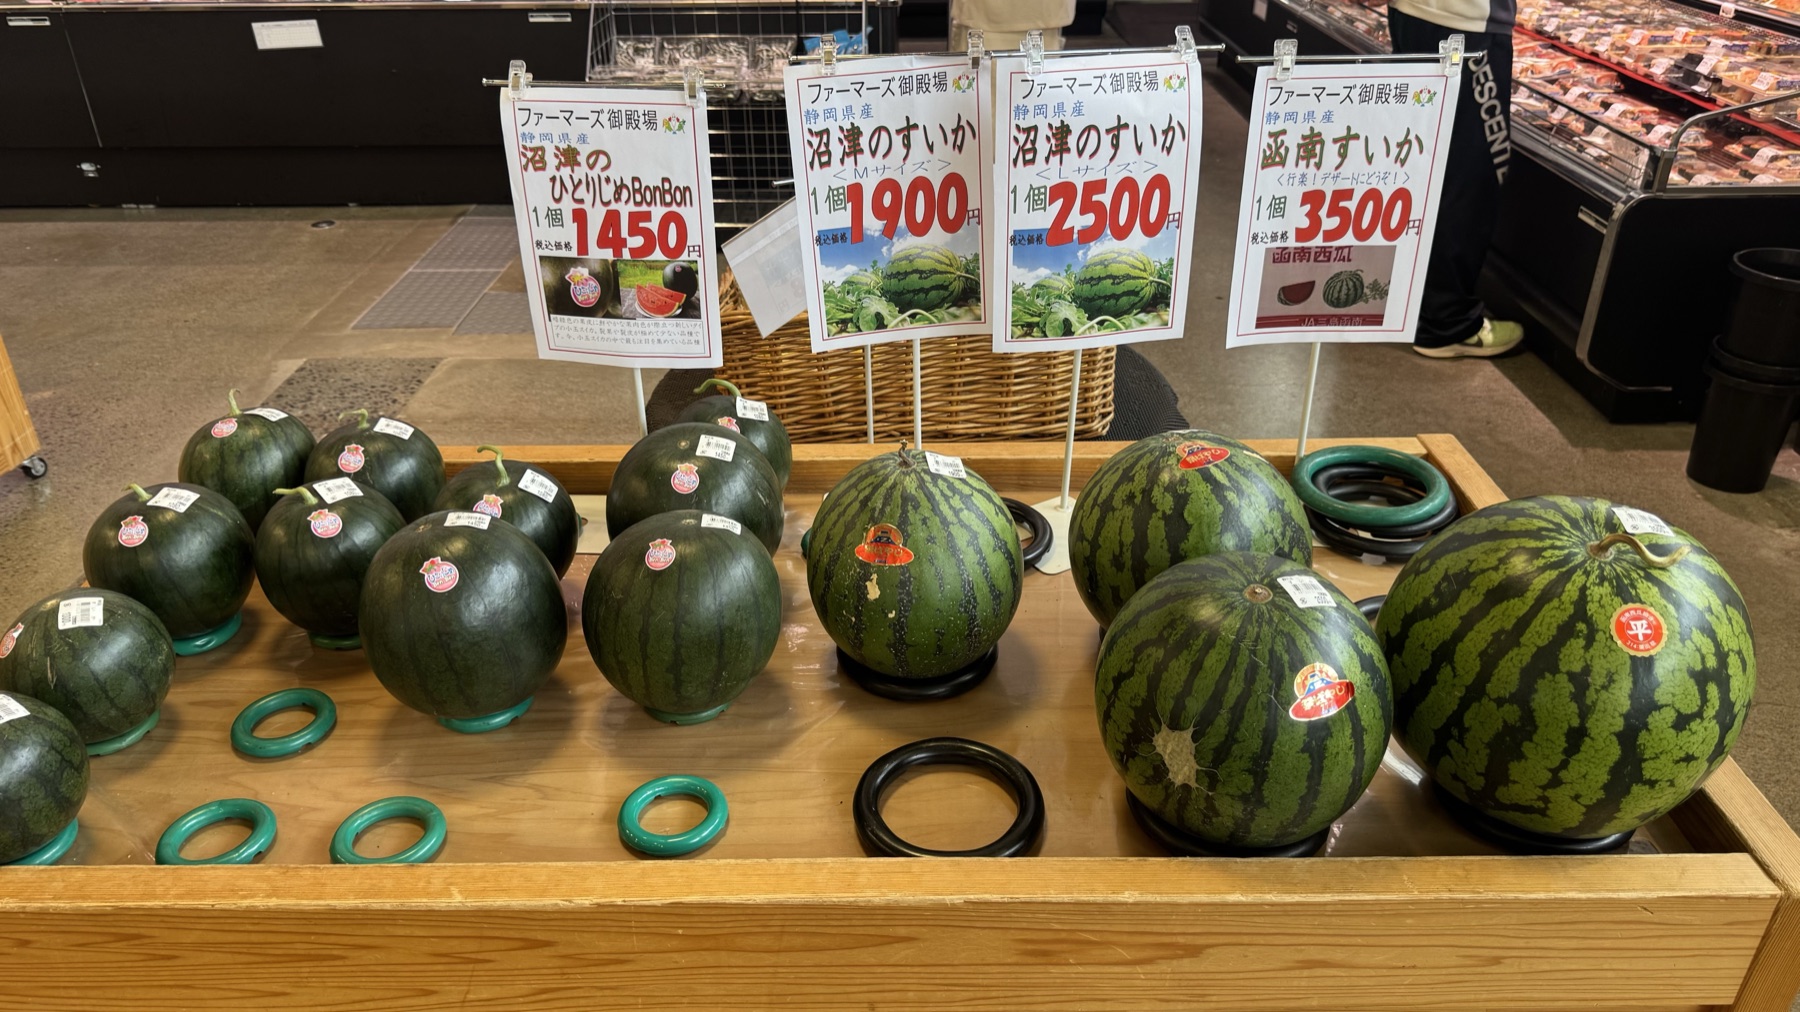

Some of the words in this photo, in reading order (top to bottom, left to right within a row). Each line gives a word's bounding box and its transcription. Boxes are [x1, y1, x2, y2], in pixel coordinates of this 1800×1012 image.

[807, 71, 948, 104] ファーマーズ御殿場
[1020, 70, 1159, 100] ファーマーズ御殿場
[1269, 83, 1410, 107] ファーマーズ御殿場
[517, 107, 658, 131] ファーマーズ御殿場
[803, 103, 874, 125] 静岡県産
[1012, 100, 1085, 121] 静岡県産
[1265, 110, 1335, 125] 静岡県産
[519, 132, 590, 145] 静岡県産
[806, 113, 977, 171] 沼津のすいか
[1012, 113, 1186, 168] 沼津のすいか
[1260, 125, 1424, 172] 函南すいか
[520, 144, 611, 172] 沼津の
[550, 172, 694, 208] ひとりじめBonBon
[535, 240, 572, 252] 税込価格
[815, 232, 848, 247] 税込価格
[1009, 234, 1044, 247] 税込価格
[1250, 230, 1289, 245] 税込価格
[1272, 245, 1353, 264] 函南西瓜
[1626, 619, 1652, 641] 平
